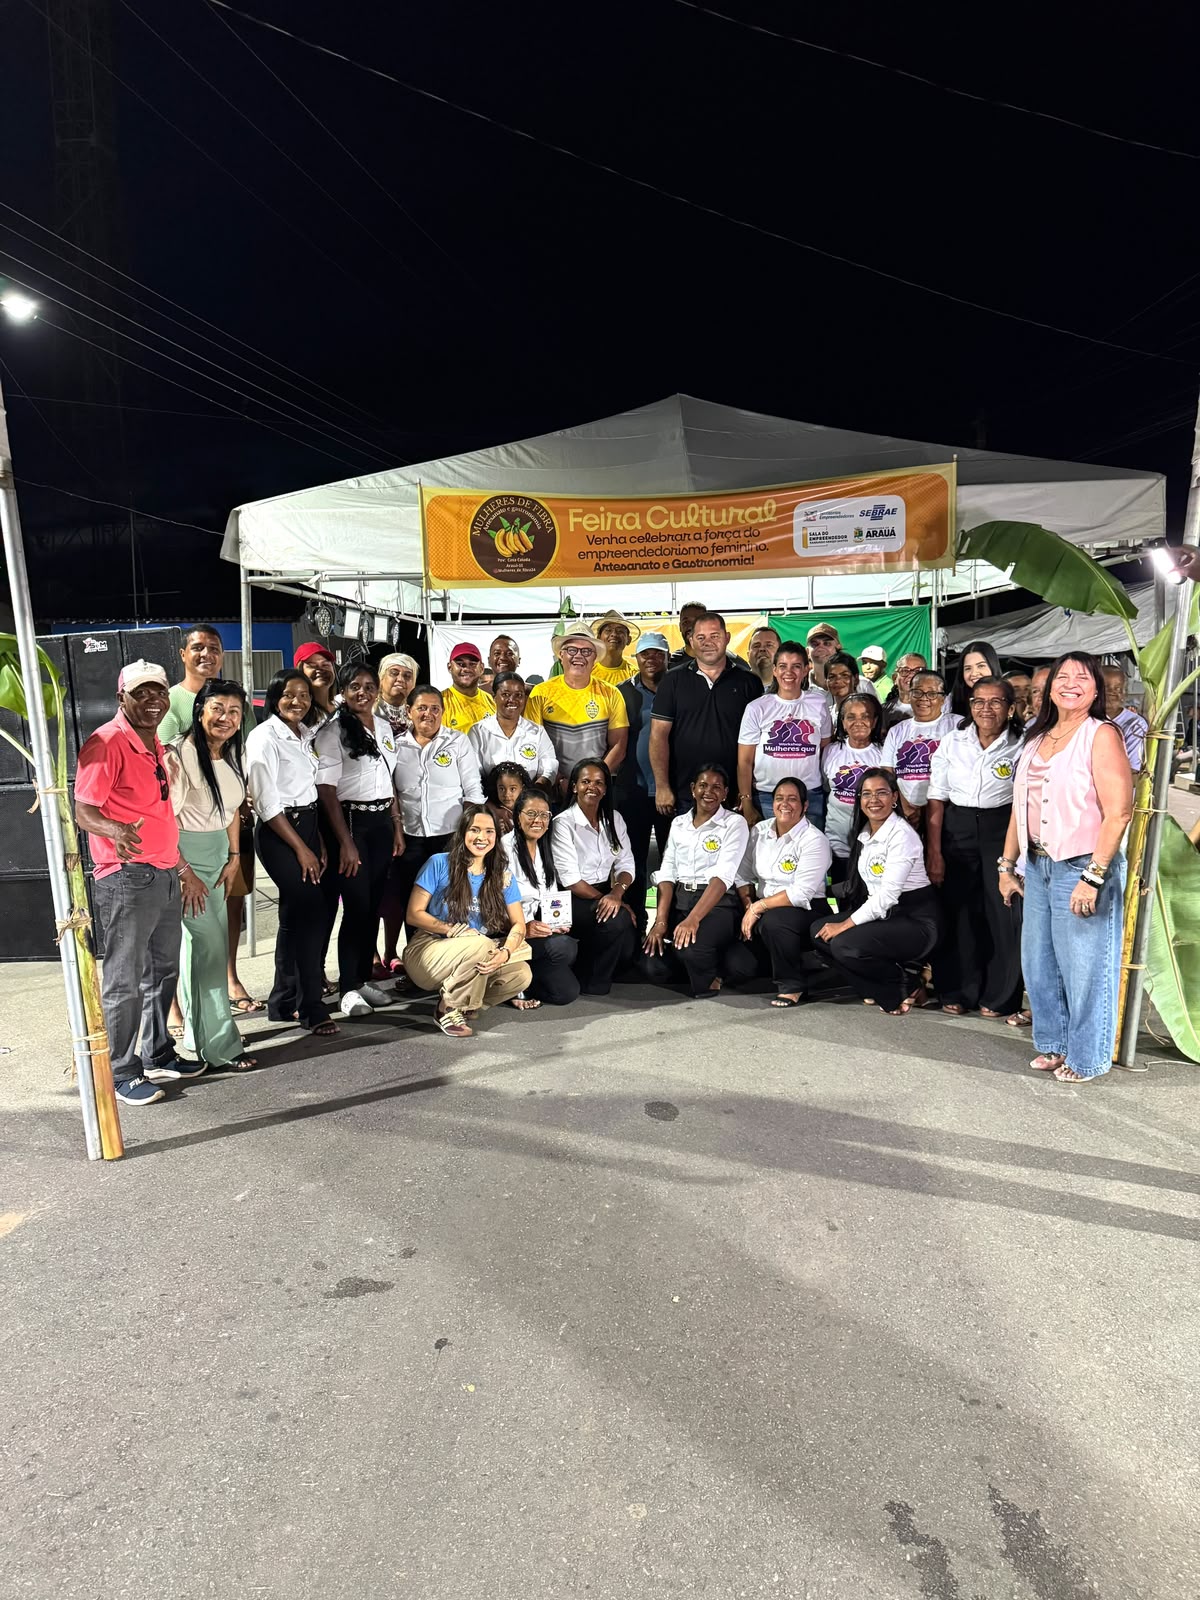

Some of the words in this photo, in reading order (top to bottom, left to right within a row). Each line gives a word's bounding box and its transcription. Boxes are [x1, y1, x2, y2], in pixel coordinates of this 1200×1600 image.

[472, 497, 515, 536] MULHERES
[517, 498, 532, 508] DE
[532, 505, 554, 533] FIBRA
[568, 506, 642, 532] Feira
[646, 499, 777, 529] Cultural
[859, 508, 898, 517] SEBRAE
[586, 534, 627, 546] Venha
[629, 531, 691, 544] celebrar
[693, 532, 702, 541] a
[704, 529, 741, 542] força
[743, 527, 760, 538] do
[865, 527, 896, 538] ARAUÁ
[578, 544, 709, 561] empreendedorismo
[711, 541, 769, 556] feminino.
[593, 561, 661, 572] Artesanato
[671, 555, 755, 569] Gastronomia!
